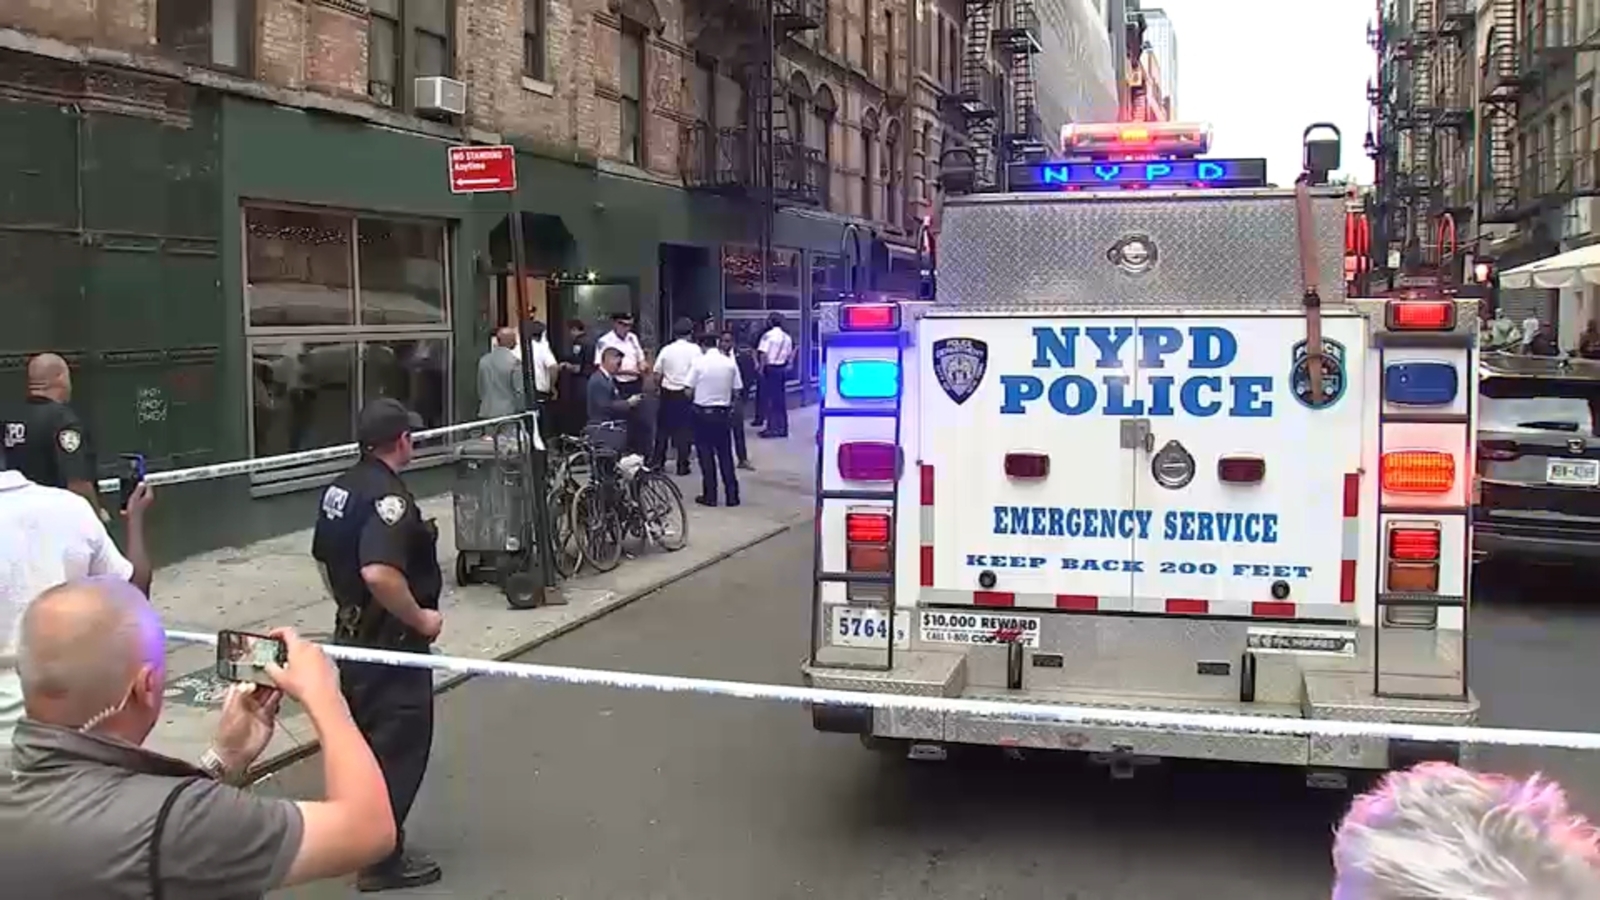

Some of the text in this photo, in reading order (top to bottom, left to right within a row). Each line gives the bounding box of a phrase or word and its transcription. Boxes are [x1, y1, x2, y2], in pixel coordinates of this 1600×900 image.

[1044, 163, 1223, 183] NYPD
[1032, 326, 1238, 369] NYPD
[1000, 375, 1274, 418] POLICE
[993, 506, 1278, 543] EMERGENCY SERVICE
[966, 554, 1313, 578] KEEP BACK 200 FEET
[839, 618, 887, 638] 5764
[923, 613, 1038, 630] $10,000 REWARD
